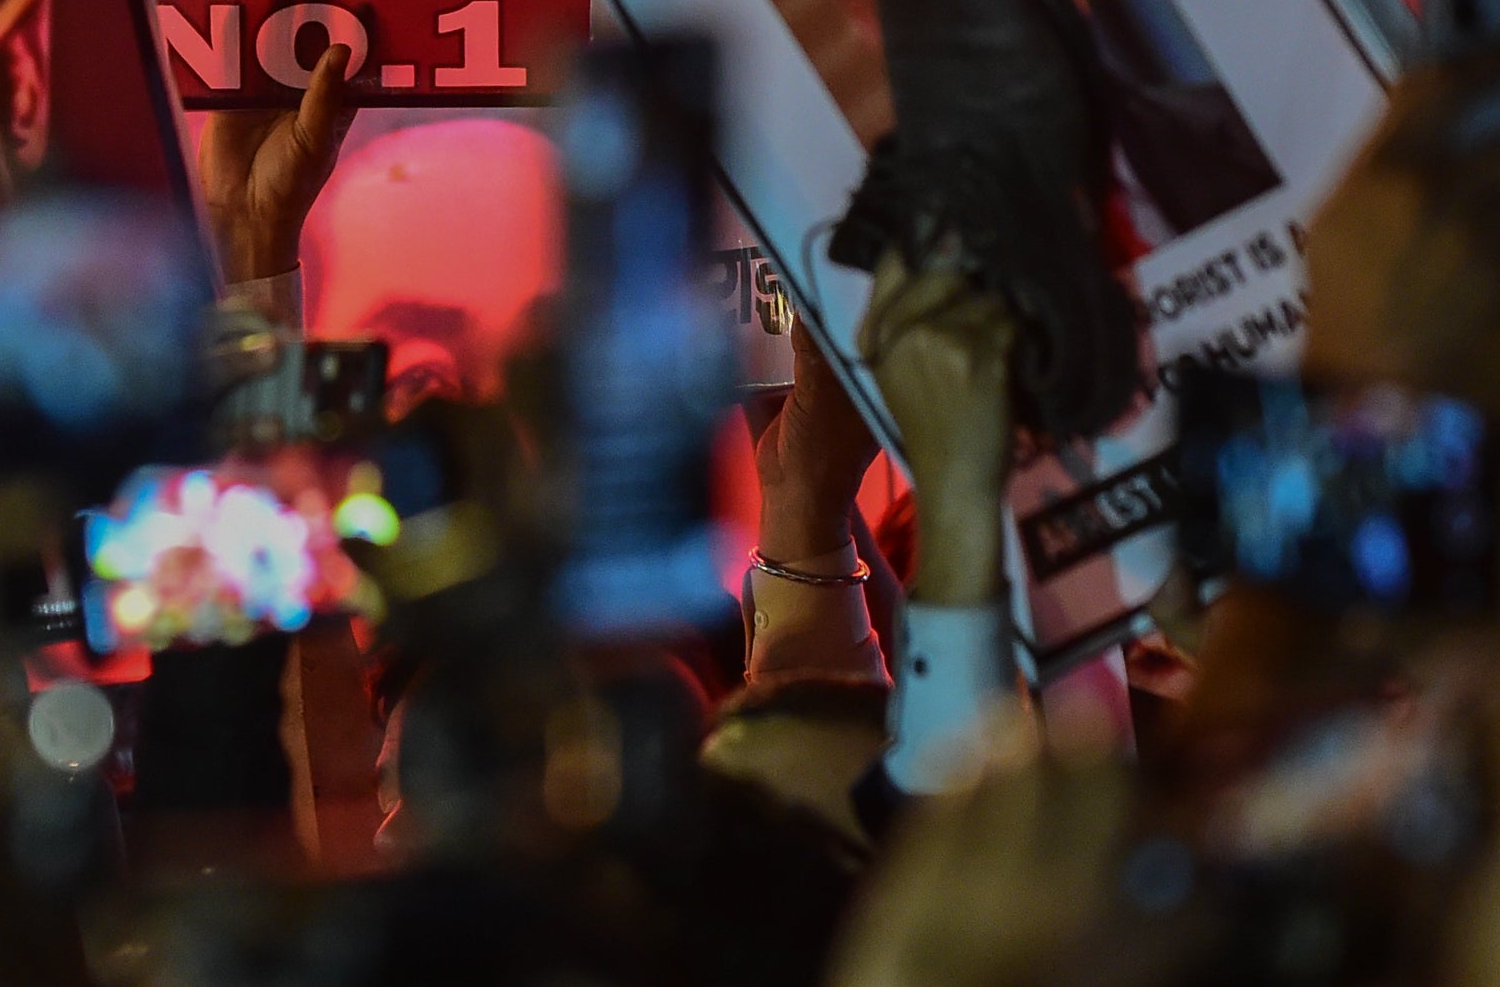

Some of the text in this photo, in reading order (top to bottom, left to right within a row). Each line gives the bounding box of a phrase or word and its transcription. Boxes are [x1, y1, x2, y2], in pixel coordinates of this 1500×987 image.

[157, 0, 528, 90] NO.1
[1150, 249, 1247, 320] ORIST
[1201, 292, 1310, 368] HUMA
